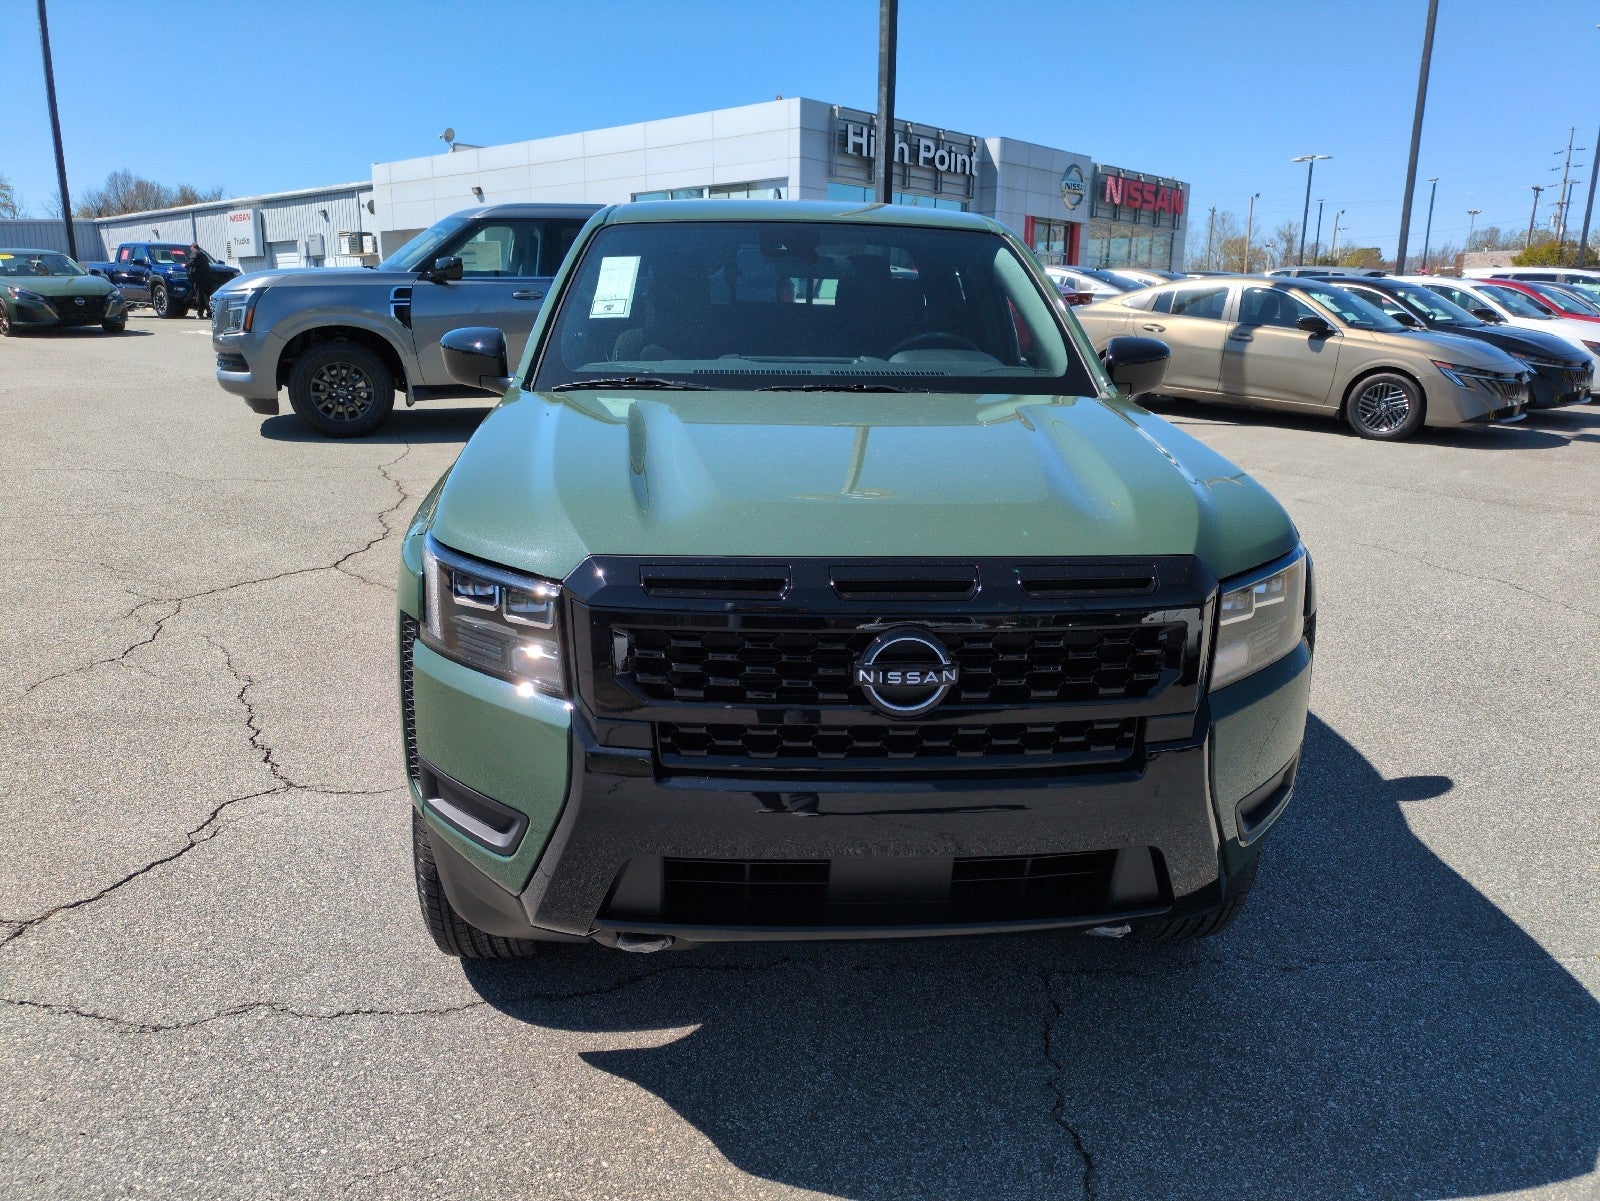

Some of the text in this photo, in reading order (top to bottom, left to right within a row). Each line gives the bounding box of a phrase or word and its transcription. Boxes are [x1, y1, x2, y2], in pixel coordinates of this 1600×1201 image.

[846, 123, 979, 176] Hih Point
[1105, 175, 1185, 216] NISSAN
[229, 213, 251, 222] NISSAN
[233, 237, 250, 245] Trucks
[858, 669, 956, 684] NISSAN
